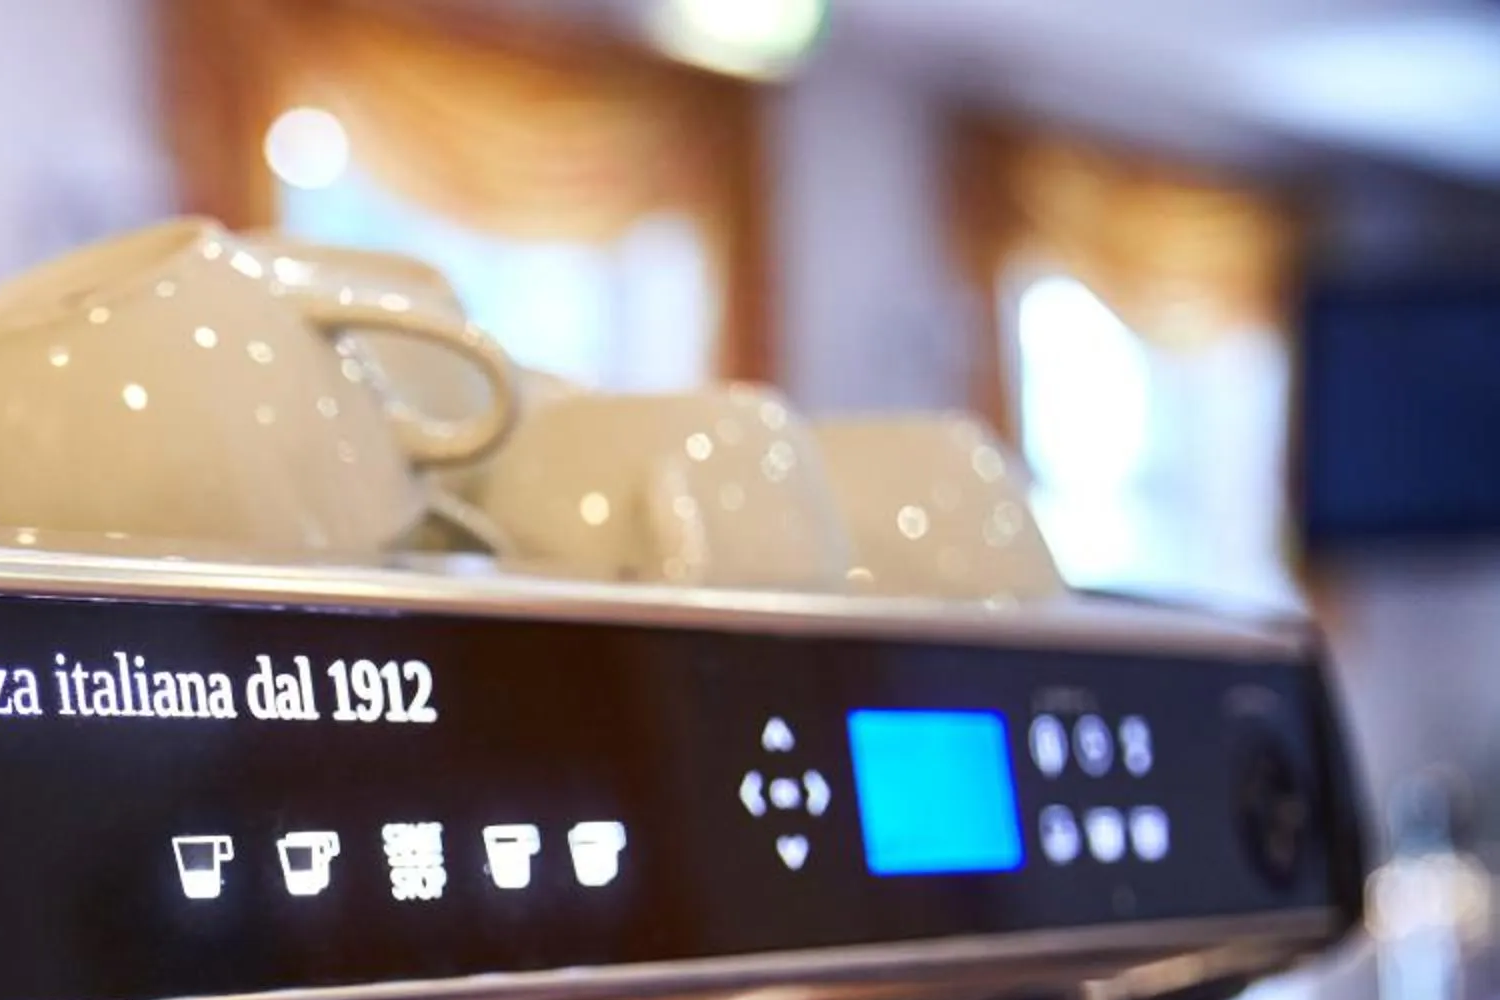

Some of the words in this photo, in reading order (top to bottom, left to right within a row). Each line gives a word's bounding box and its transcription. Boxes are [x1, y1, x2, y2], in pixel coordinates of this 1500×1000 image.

[53, 651, 239, 720] italiana
[245, 654, 321, 721] dal
[326, 658, 438, 724] 1912
